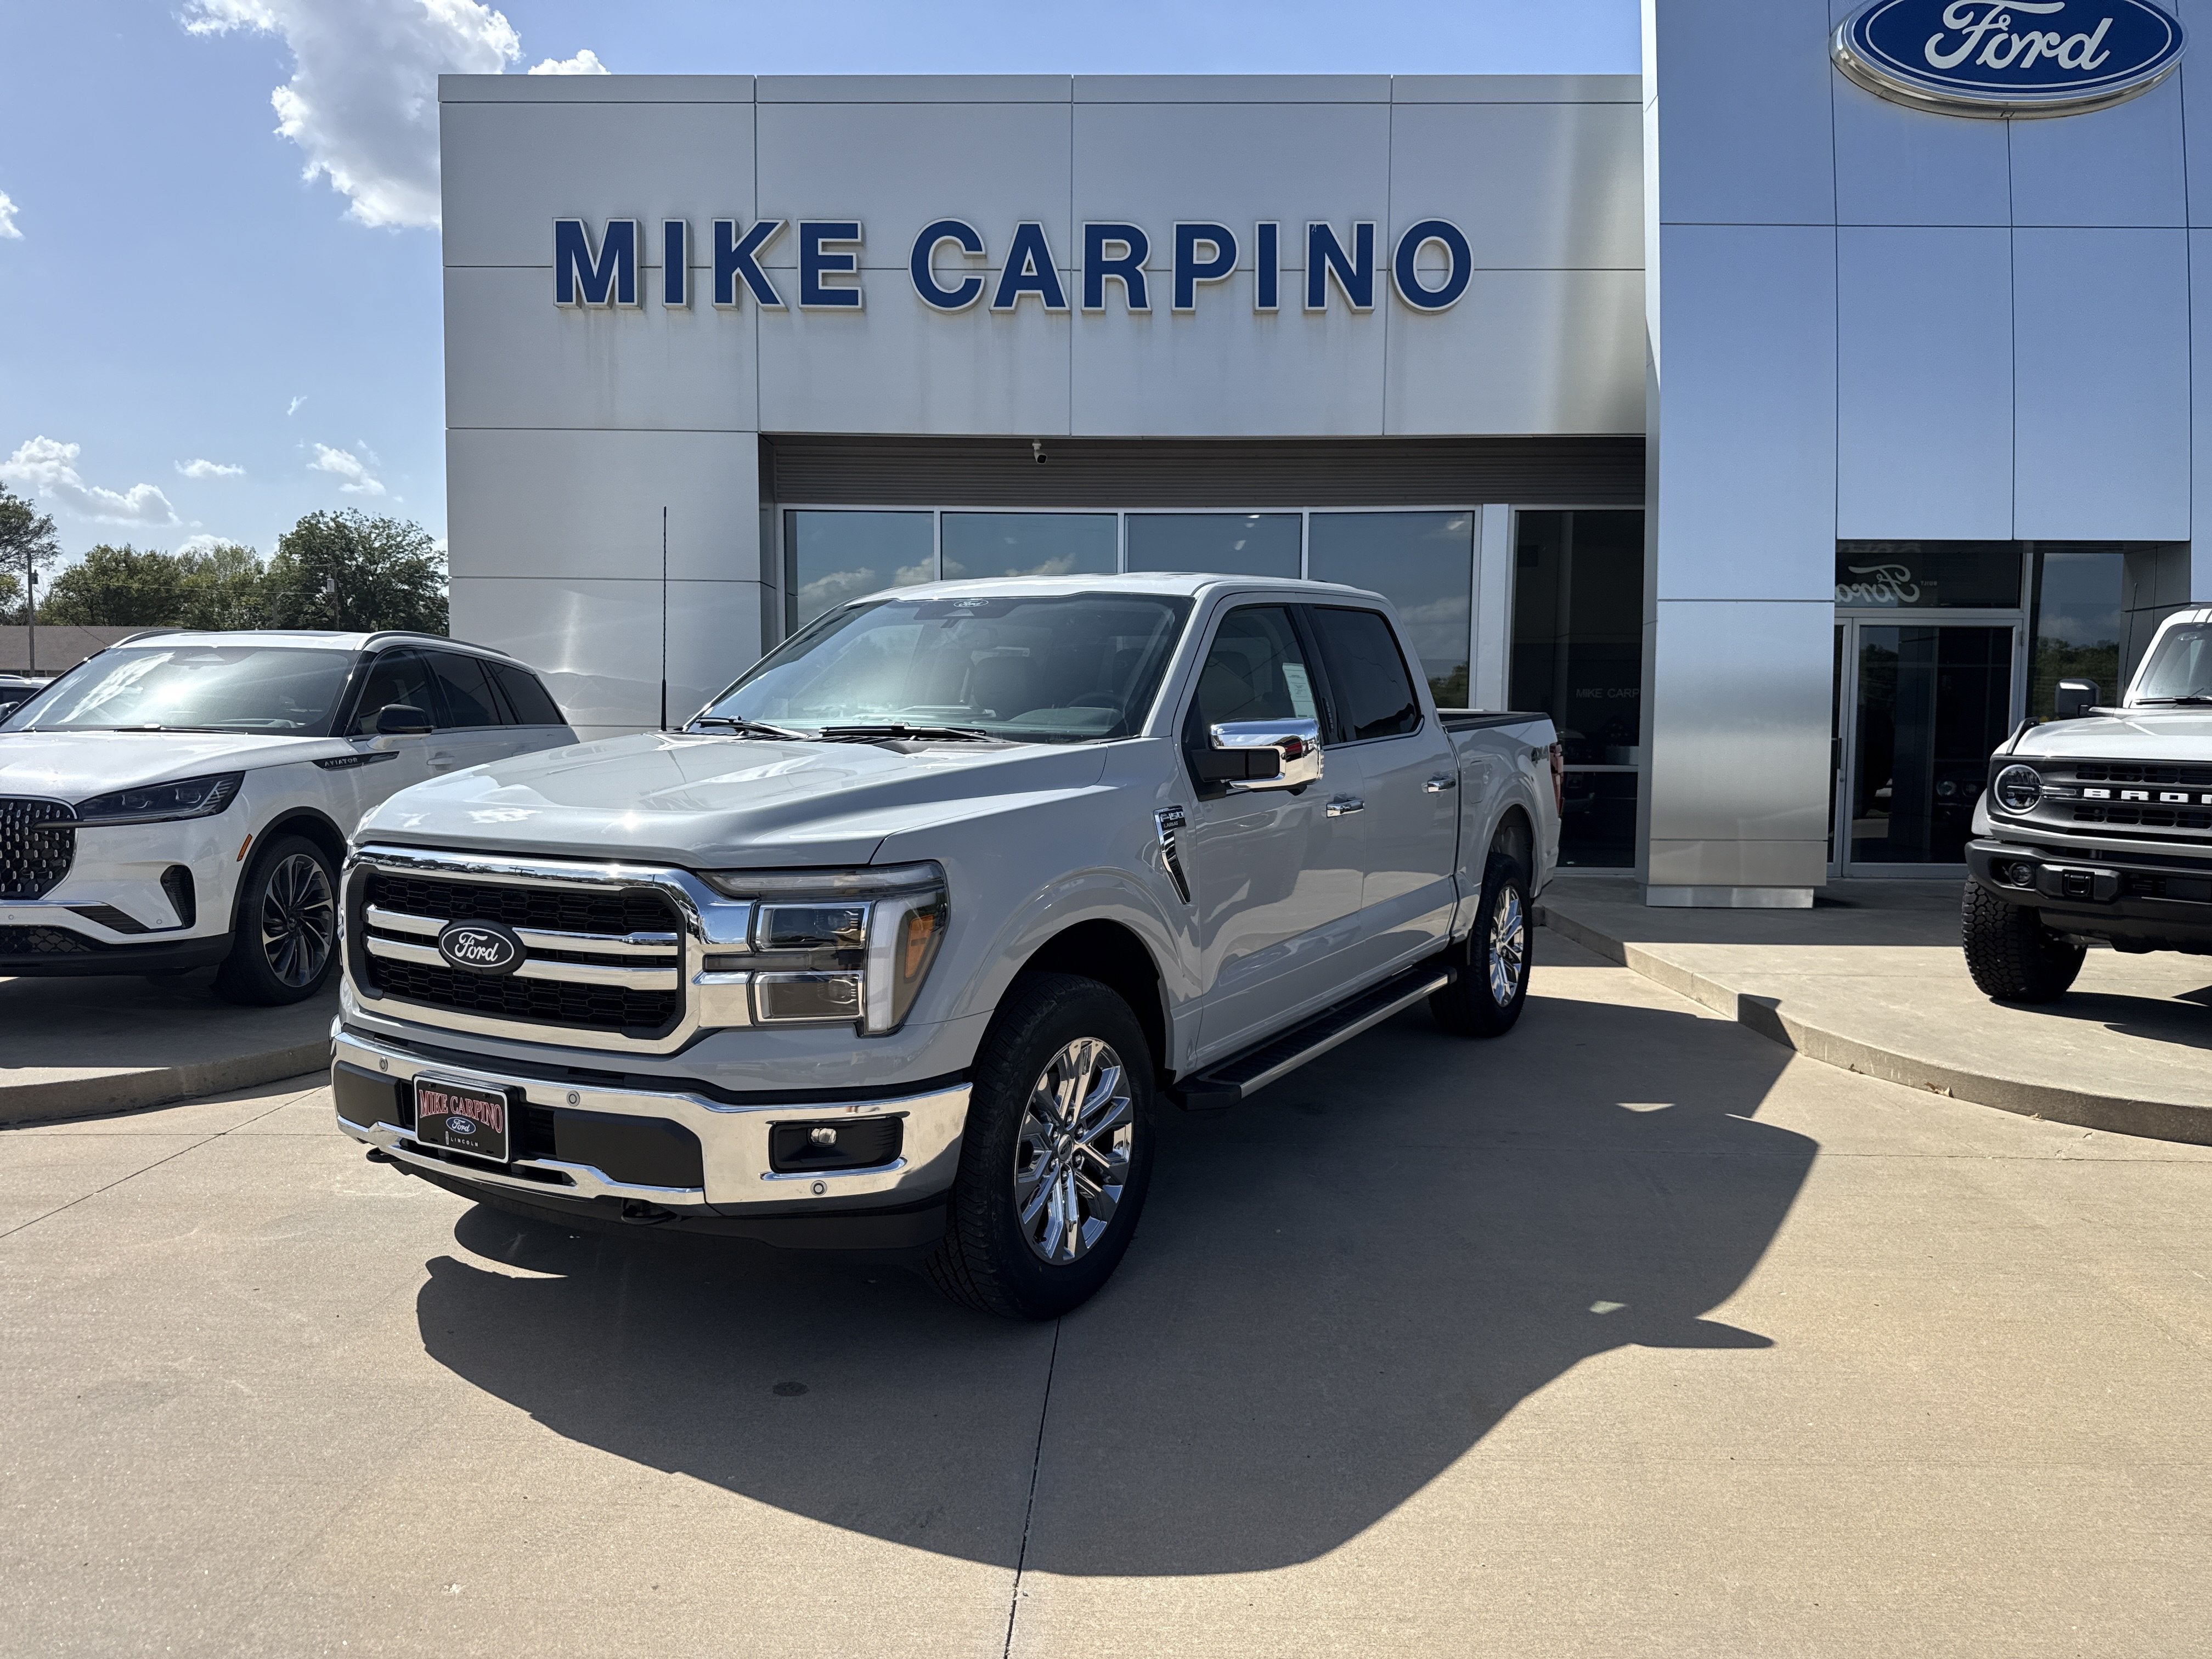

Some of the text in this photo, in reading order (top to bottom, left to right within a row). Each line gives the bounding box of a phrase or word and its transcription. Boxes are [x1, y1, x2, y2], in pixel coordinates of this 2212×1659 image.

[1925, 0, 2113, 70] Ford
[552, 217, 1475, 314] MIKE CARPINO
[1576, 688, 1603, 698] MIKE
[324, 757, 358, 767] AVIATOR
[455, 932, 499, 962] Ford
[419, 1089, 503, 1134] MIKE CARPINO
[452, 1118, 471, 1132] Ford
[450, 1136, 479, 1147] LINCOLN
